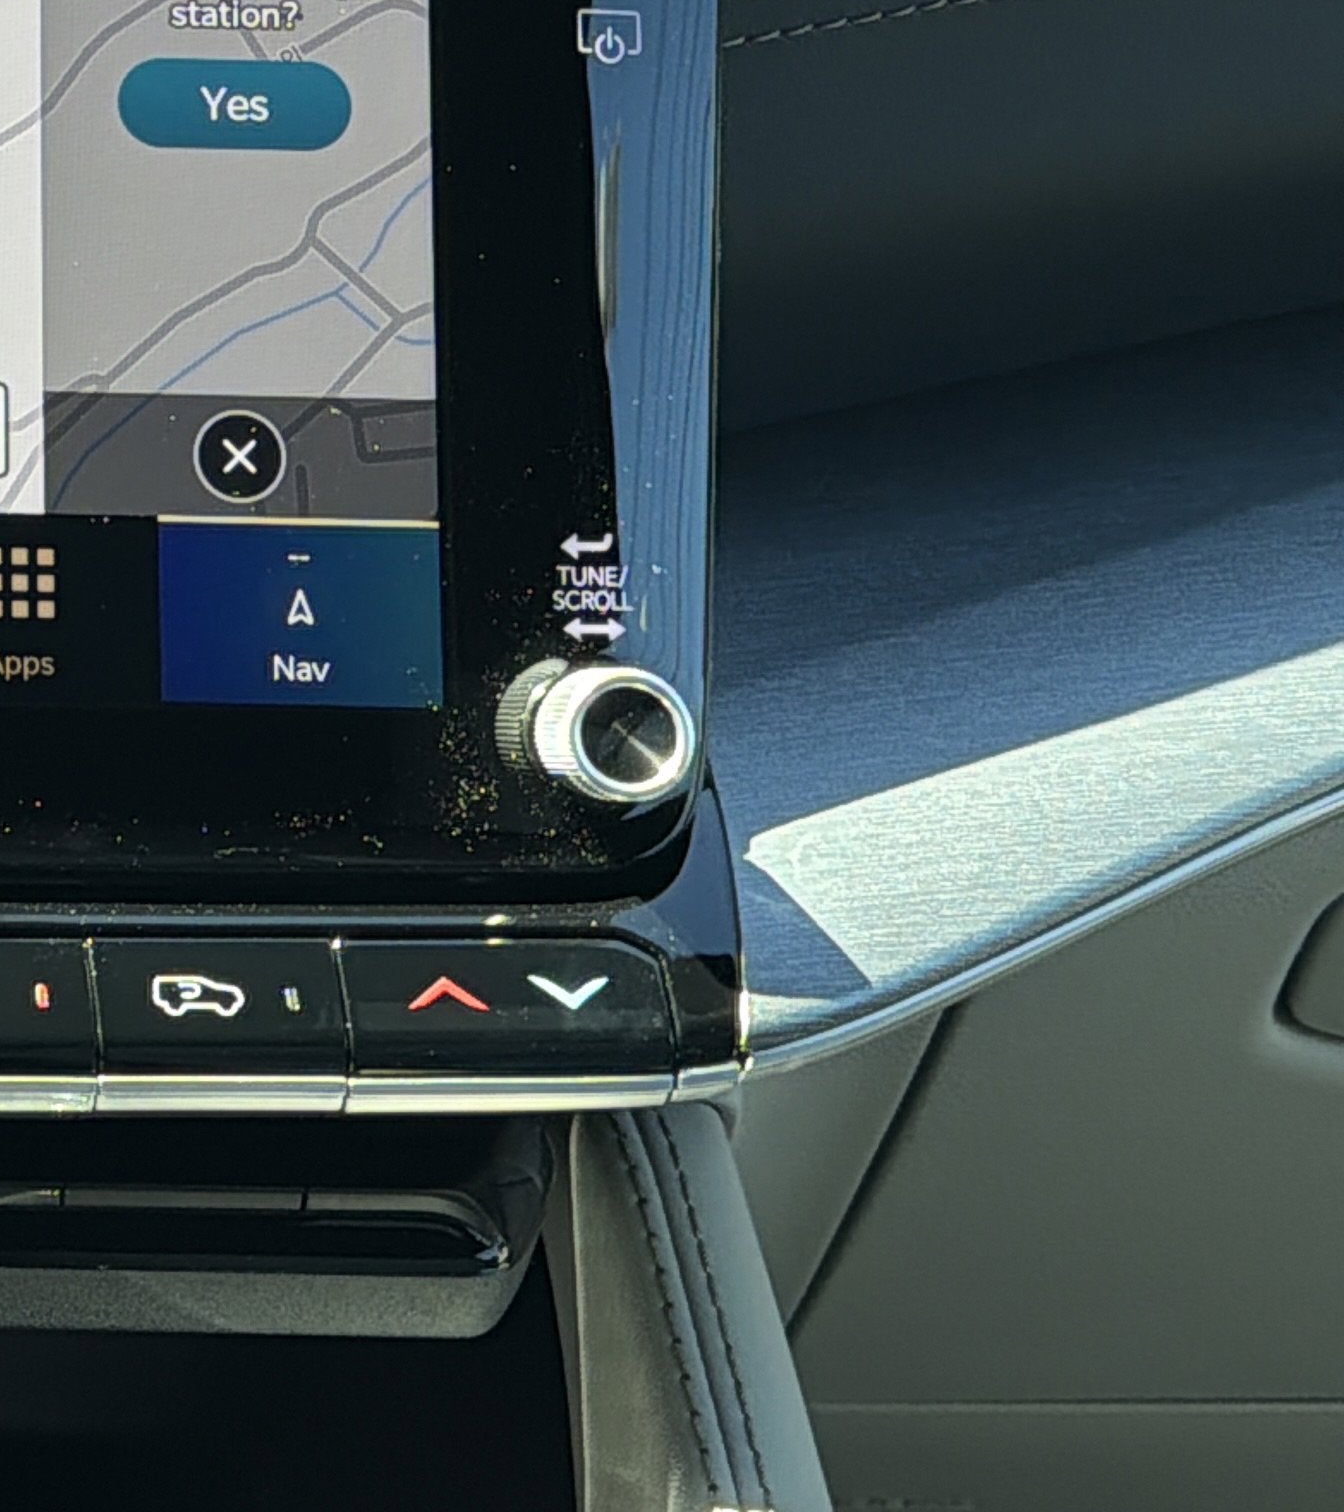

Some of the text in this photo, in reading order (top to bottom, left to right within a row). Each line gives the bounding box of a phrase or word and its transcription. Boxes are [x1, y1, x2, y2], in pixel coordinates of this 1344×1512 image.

[171, 0, 300, 28] station?
[200, 86, 270, 122] Yes
[555, 565, 629, 588] TUNE/
[552, 589, 634, 612] SCROLL
[273, 654, 331, 682] Nav
